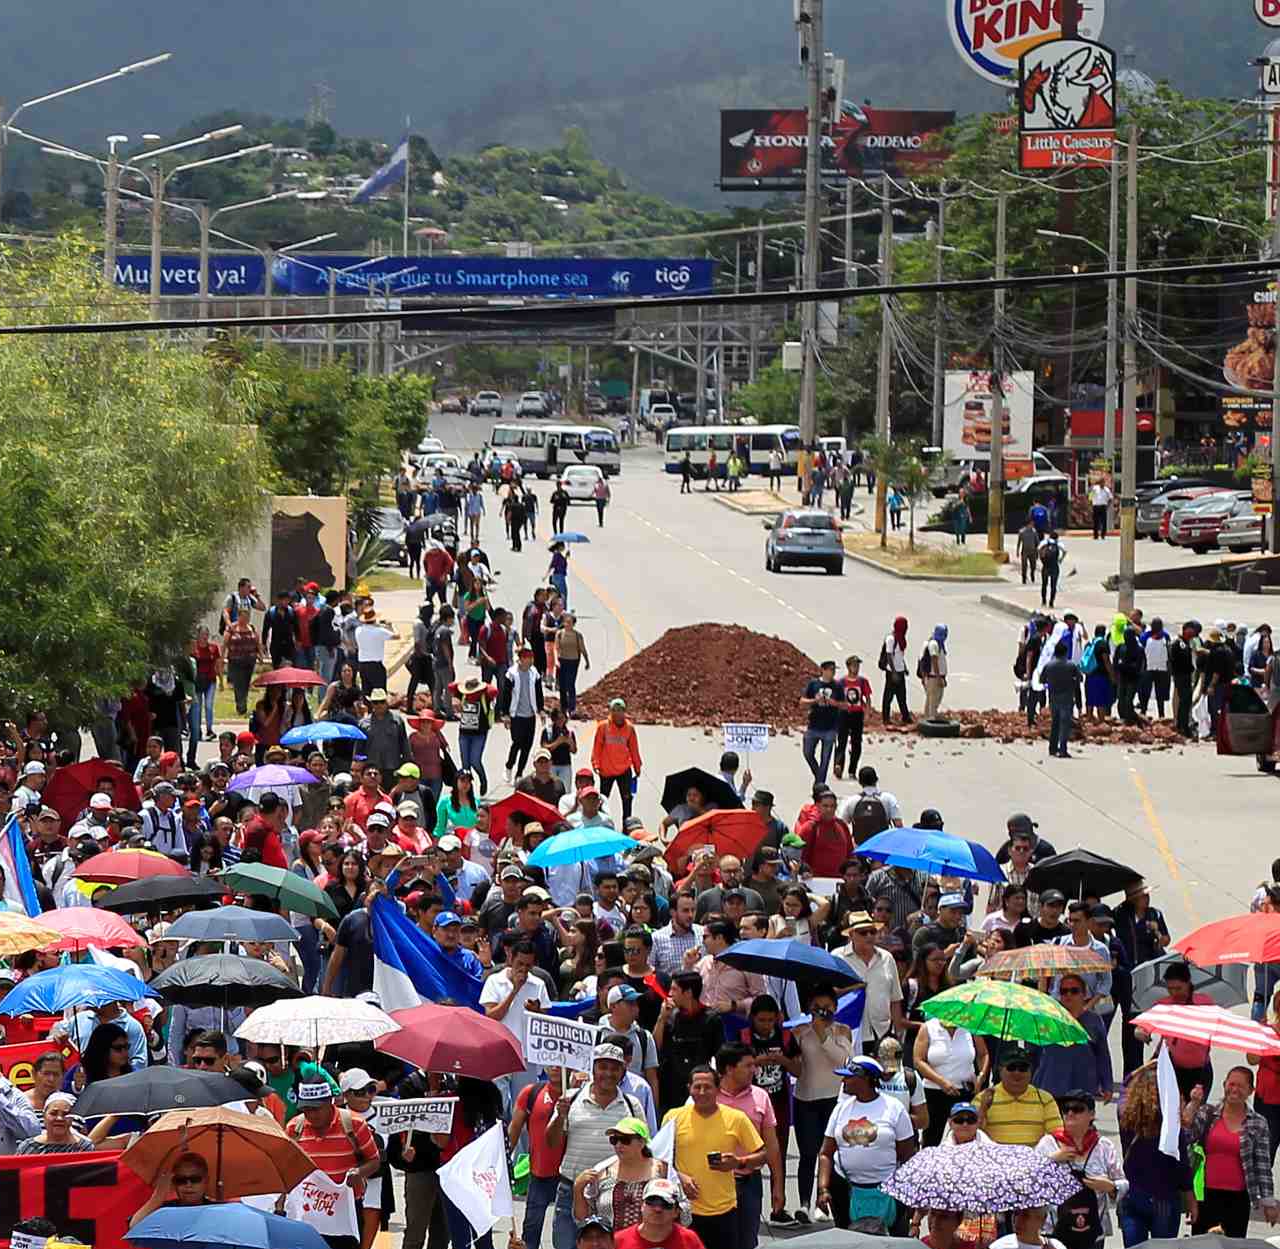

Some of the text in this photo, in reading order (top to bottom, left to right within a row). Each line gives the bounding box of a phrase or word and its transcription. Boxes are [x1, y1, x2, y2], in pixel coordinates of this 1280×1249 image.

[973, 0, 1083, 50] KIN
[1027, 134, 1112, 150] Little Caesars
[215, 264, 246, 288] ya!
[435, 269, 451, 284] tu
[456, 269, 560, 289] Smartphone
[563, 271, 589, 285] sea
[611, 270, 630, 284] 4G
[655, 265, 690, 288] tigo
[531, 1018, 594, 1044] RENUNCIA
[381, 1103, 450, 1117] RENUNCIA
